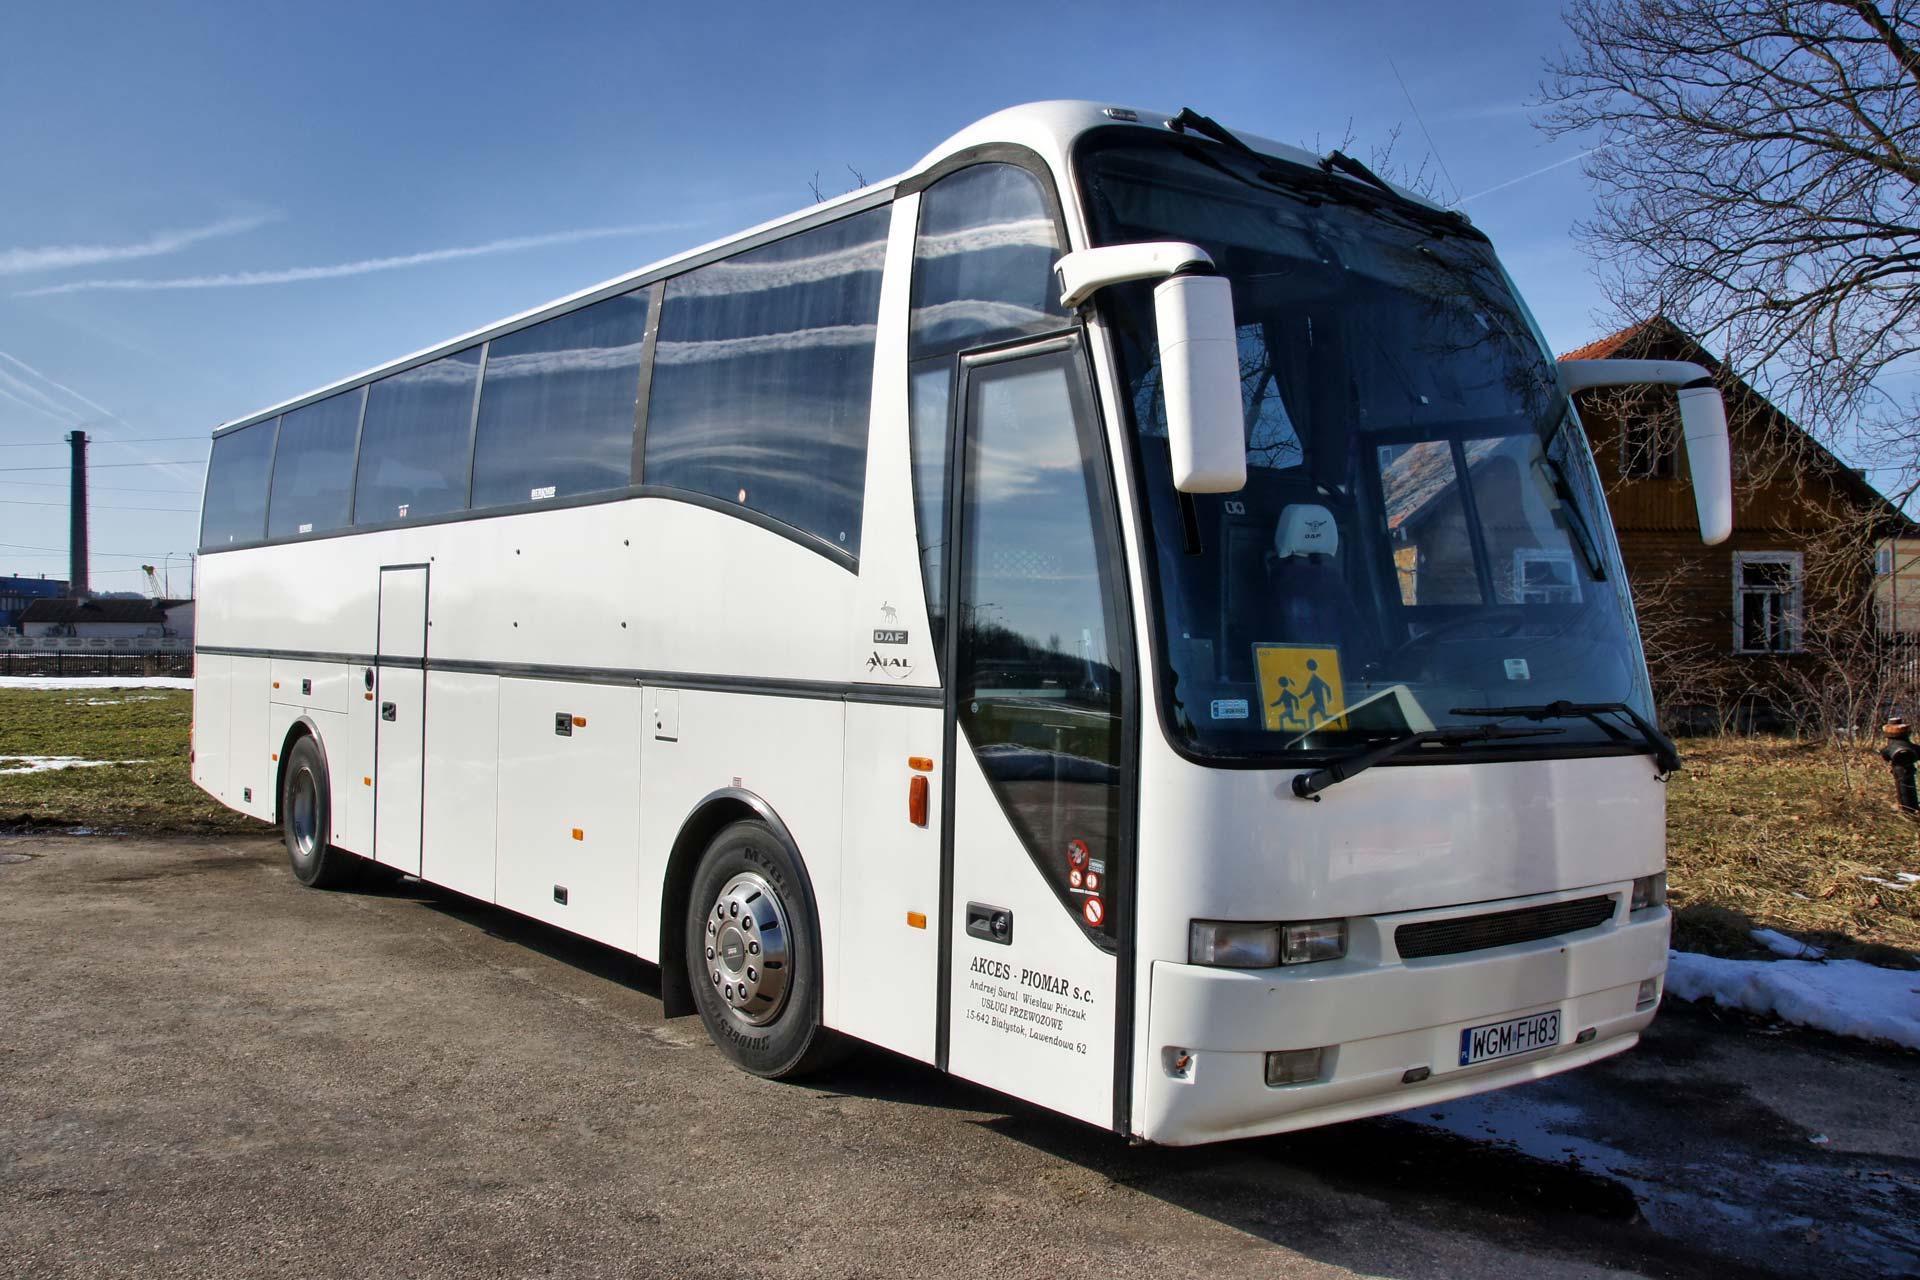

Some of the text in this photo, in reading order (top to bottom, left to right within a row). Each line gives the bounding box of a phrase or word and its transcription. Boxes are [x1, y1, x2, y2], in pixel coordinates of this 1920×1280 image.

[874, 631, 905, 642] DAF
[969, 979, 997, 997] Andrzej
[970, 956, 1011, 980] AKCES
[1020, 968, 1069, 996] PIOMAR
[966, 1009, 990, 1025] 15-642
[1029, 1028, 1074, 1051] Lawendowa
[1076, 1043, 1087, 1055] 62
[981, 997, 1064, 1031] USŁUGI PRZEWOZOWE
[1473, 1015, 1557, 1058] WGM FH83
